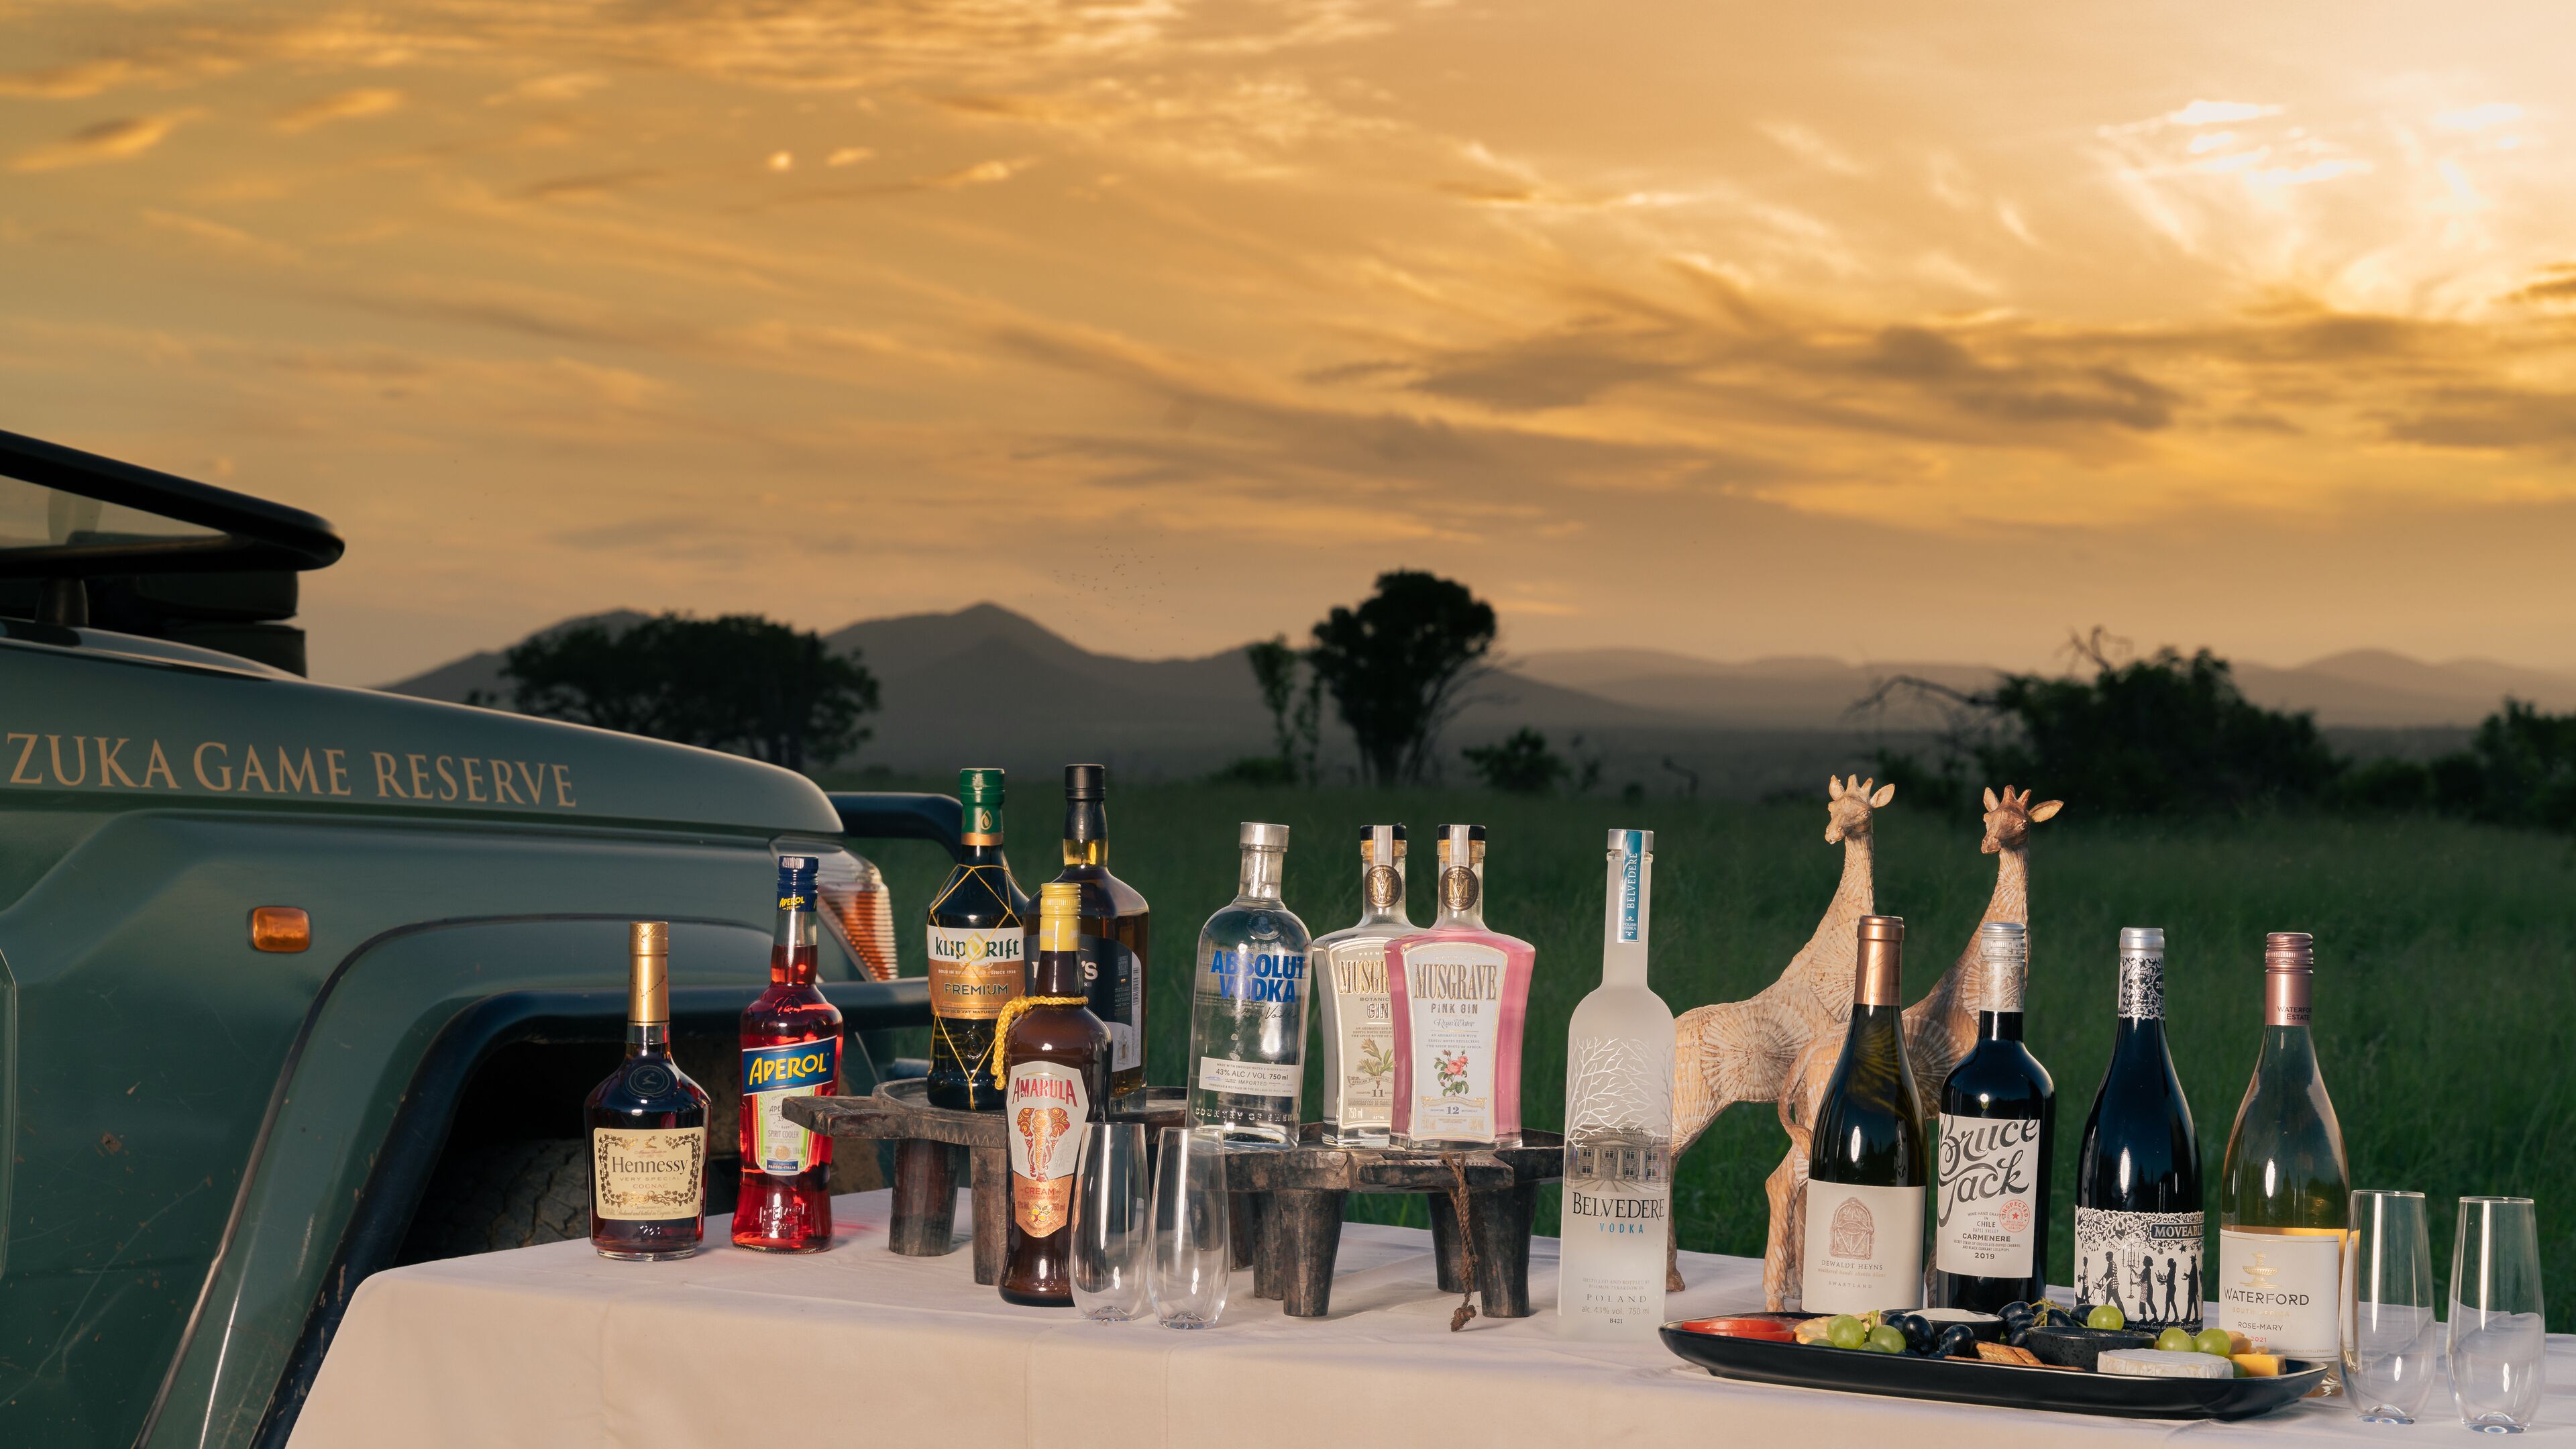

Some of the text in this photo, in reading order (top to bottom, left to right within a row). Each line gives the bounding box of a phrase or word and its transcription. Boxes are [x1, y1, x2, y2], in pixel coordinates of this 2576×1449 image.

[7, 733, 577, 808] ZUKA GAME RESERVE
[1626, 853, 1638, 909] BELVEDERE
[1211, 950, 1305, 979] ABSOLUT
[944, 983, 1008, 996] PREMIUM
[1219, 975, 1296, 1003] VODKA
[1413, 964, 1497, 1001] MUSGRAVE
[1367, 1002, 1389, 1018] GIN
[749, 1053, 826, 1085] APEROL
[1012, 1077, 1078, 1108] AMARULA
[1372, 1089, 1385, 1097] 11
[1446, 1106, 1460, 1114] 12
[1939, 1114, 2038, 1177] Bruce
[612, 1157, 688, 1175] Hennessy
[1938, 1150, 2029, 1228] Jack
[1572, 1192, 1664, 1220] BELVEDERE
[2002, 1201, 2029, 1218] INSPECTED
[1600, 1223, 1644, 1233] VODKA
[1962, 1234, 2011, 1242] CARMENERE
[1821, 1260, 1855, 1269] DEWALDT
[1587, 1293, 1646, 1303] POLAND
[2224, 1287, 2309, 1305] WATERFORD
[1594, 1306, 1609, 1314] 43%
[2238, 1322, 2284, 1331] ROSE-MARY
